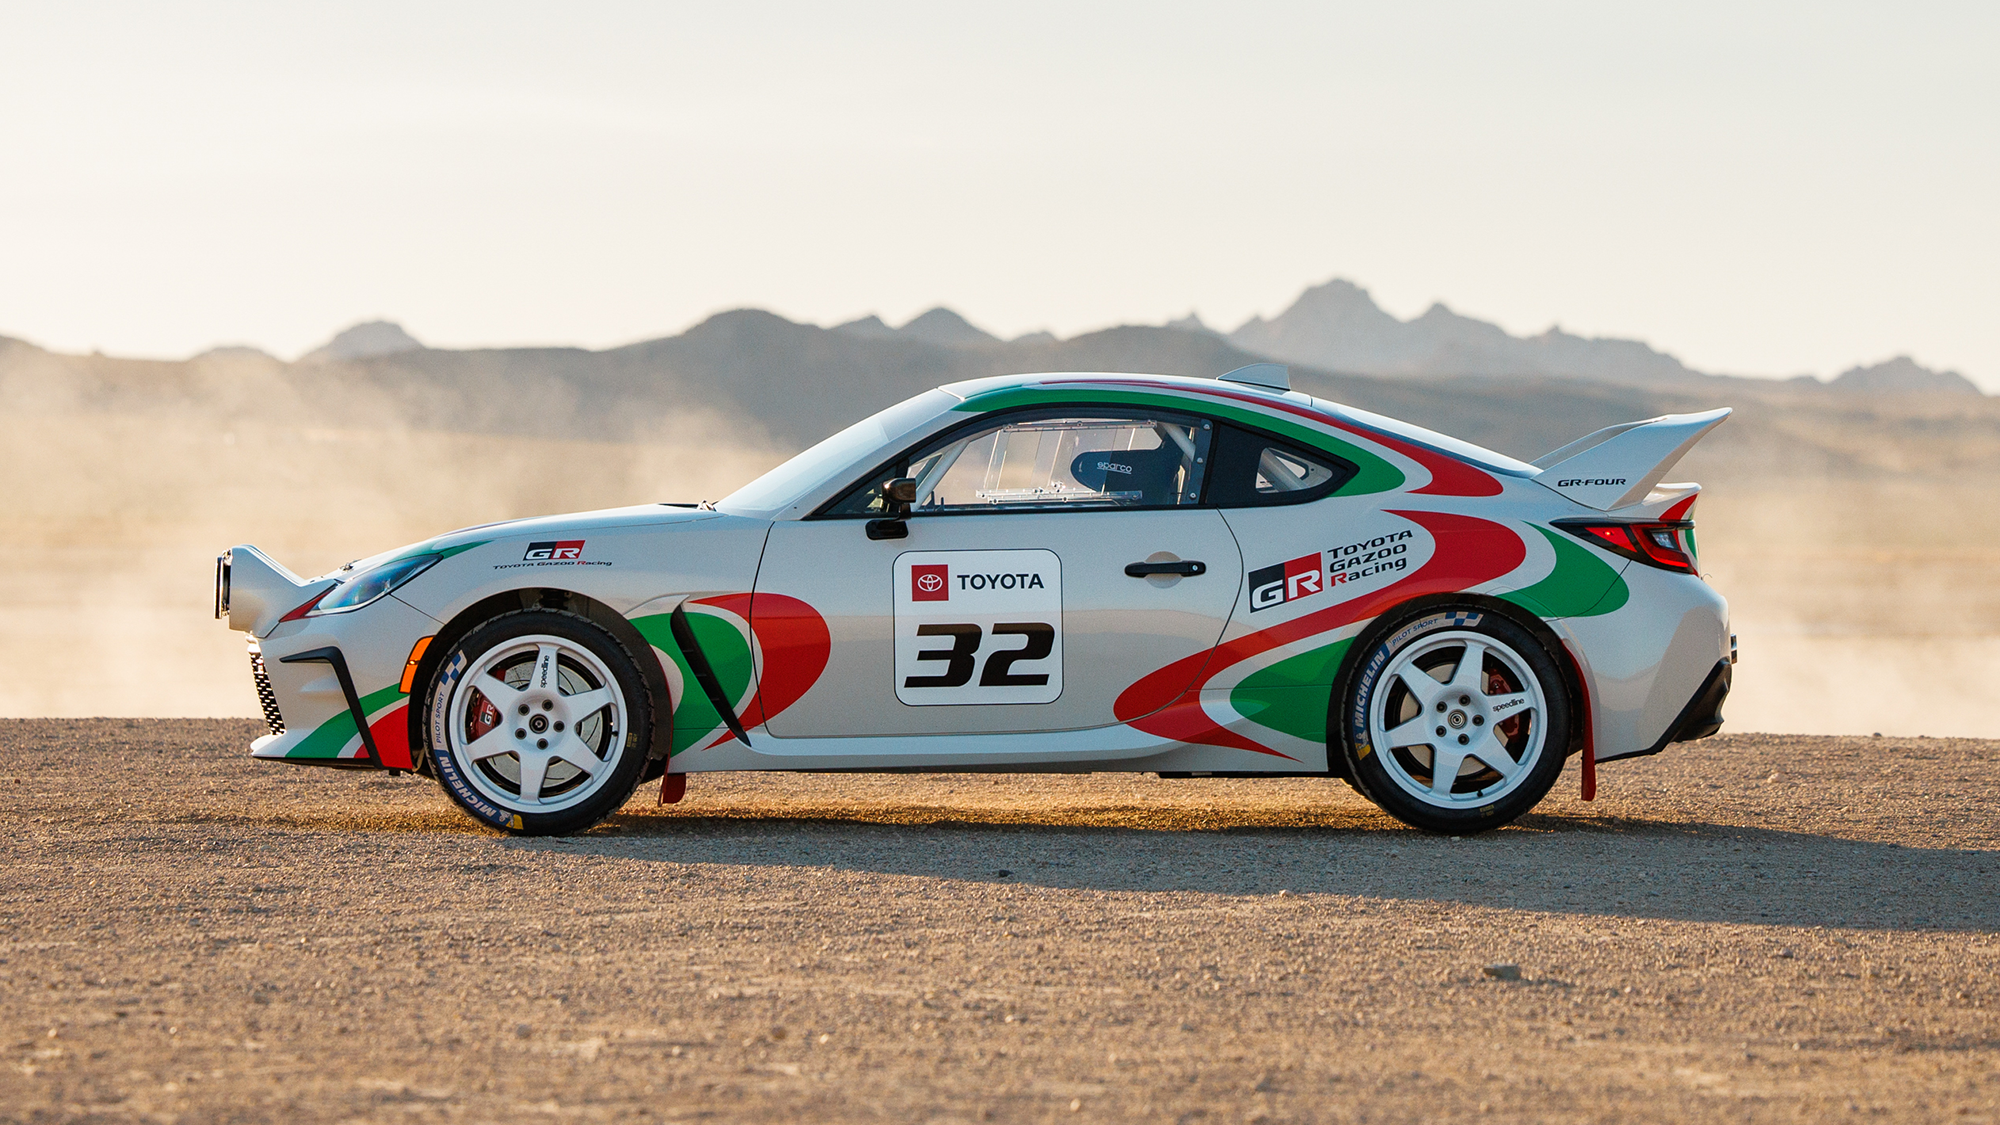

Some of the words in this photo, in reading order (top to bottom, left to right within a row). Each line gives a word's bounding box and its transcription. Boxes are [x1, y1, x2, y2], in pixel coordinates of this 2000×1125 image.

[525, 548, 580, 559] GR
[1327, 530, 1413, 560] TOYOTA
[1330, 544, 1407, 573] GAZOO
[957, 574, 1044, 590] TOYOTA
[1330, 558, 1407, 587] Racing
[1252, 569, 1321, 609] GR
[904, 622, 1055, 688] 32
[540, 655, 550, 688] speedline
[1355, 651, 1386, 728] MICHELIN
[1391, 629, 1411, 646] PILOT
[1413, 618, 1439, 632] SPORT
[437, 691, 445, 718] SPORT
[1493, 698, 1525, 712] speedline
[439, 756, 497, 818] MICHELIN
